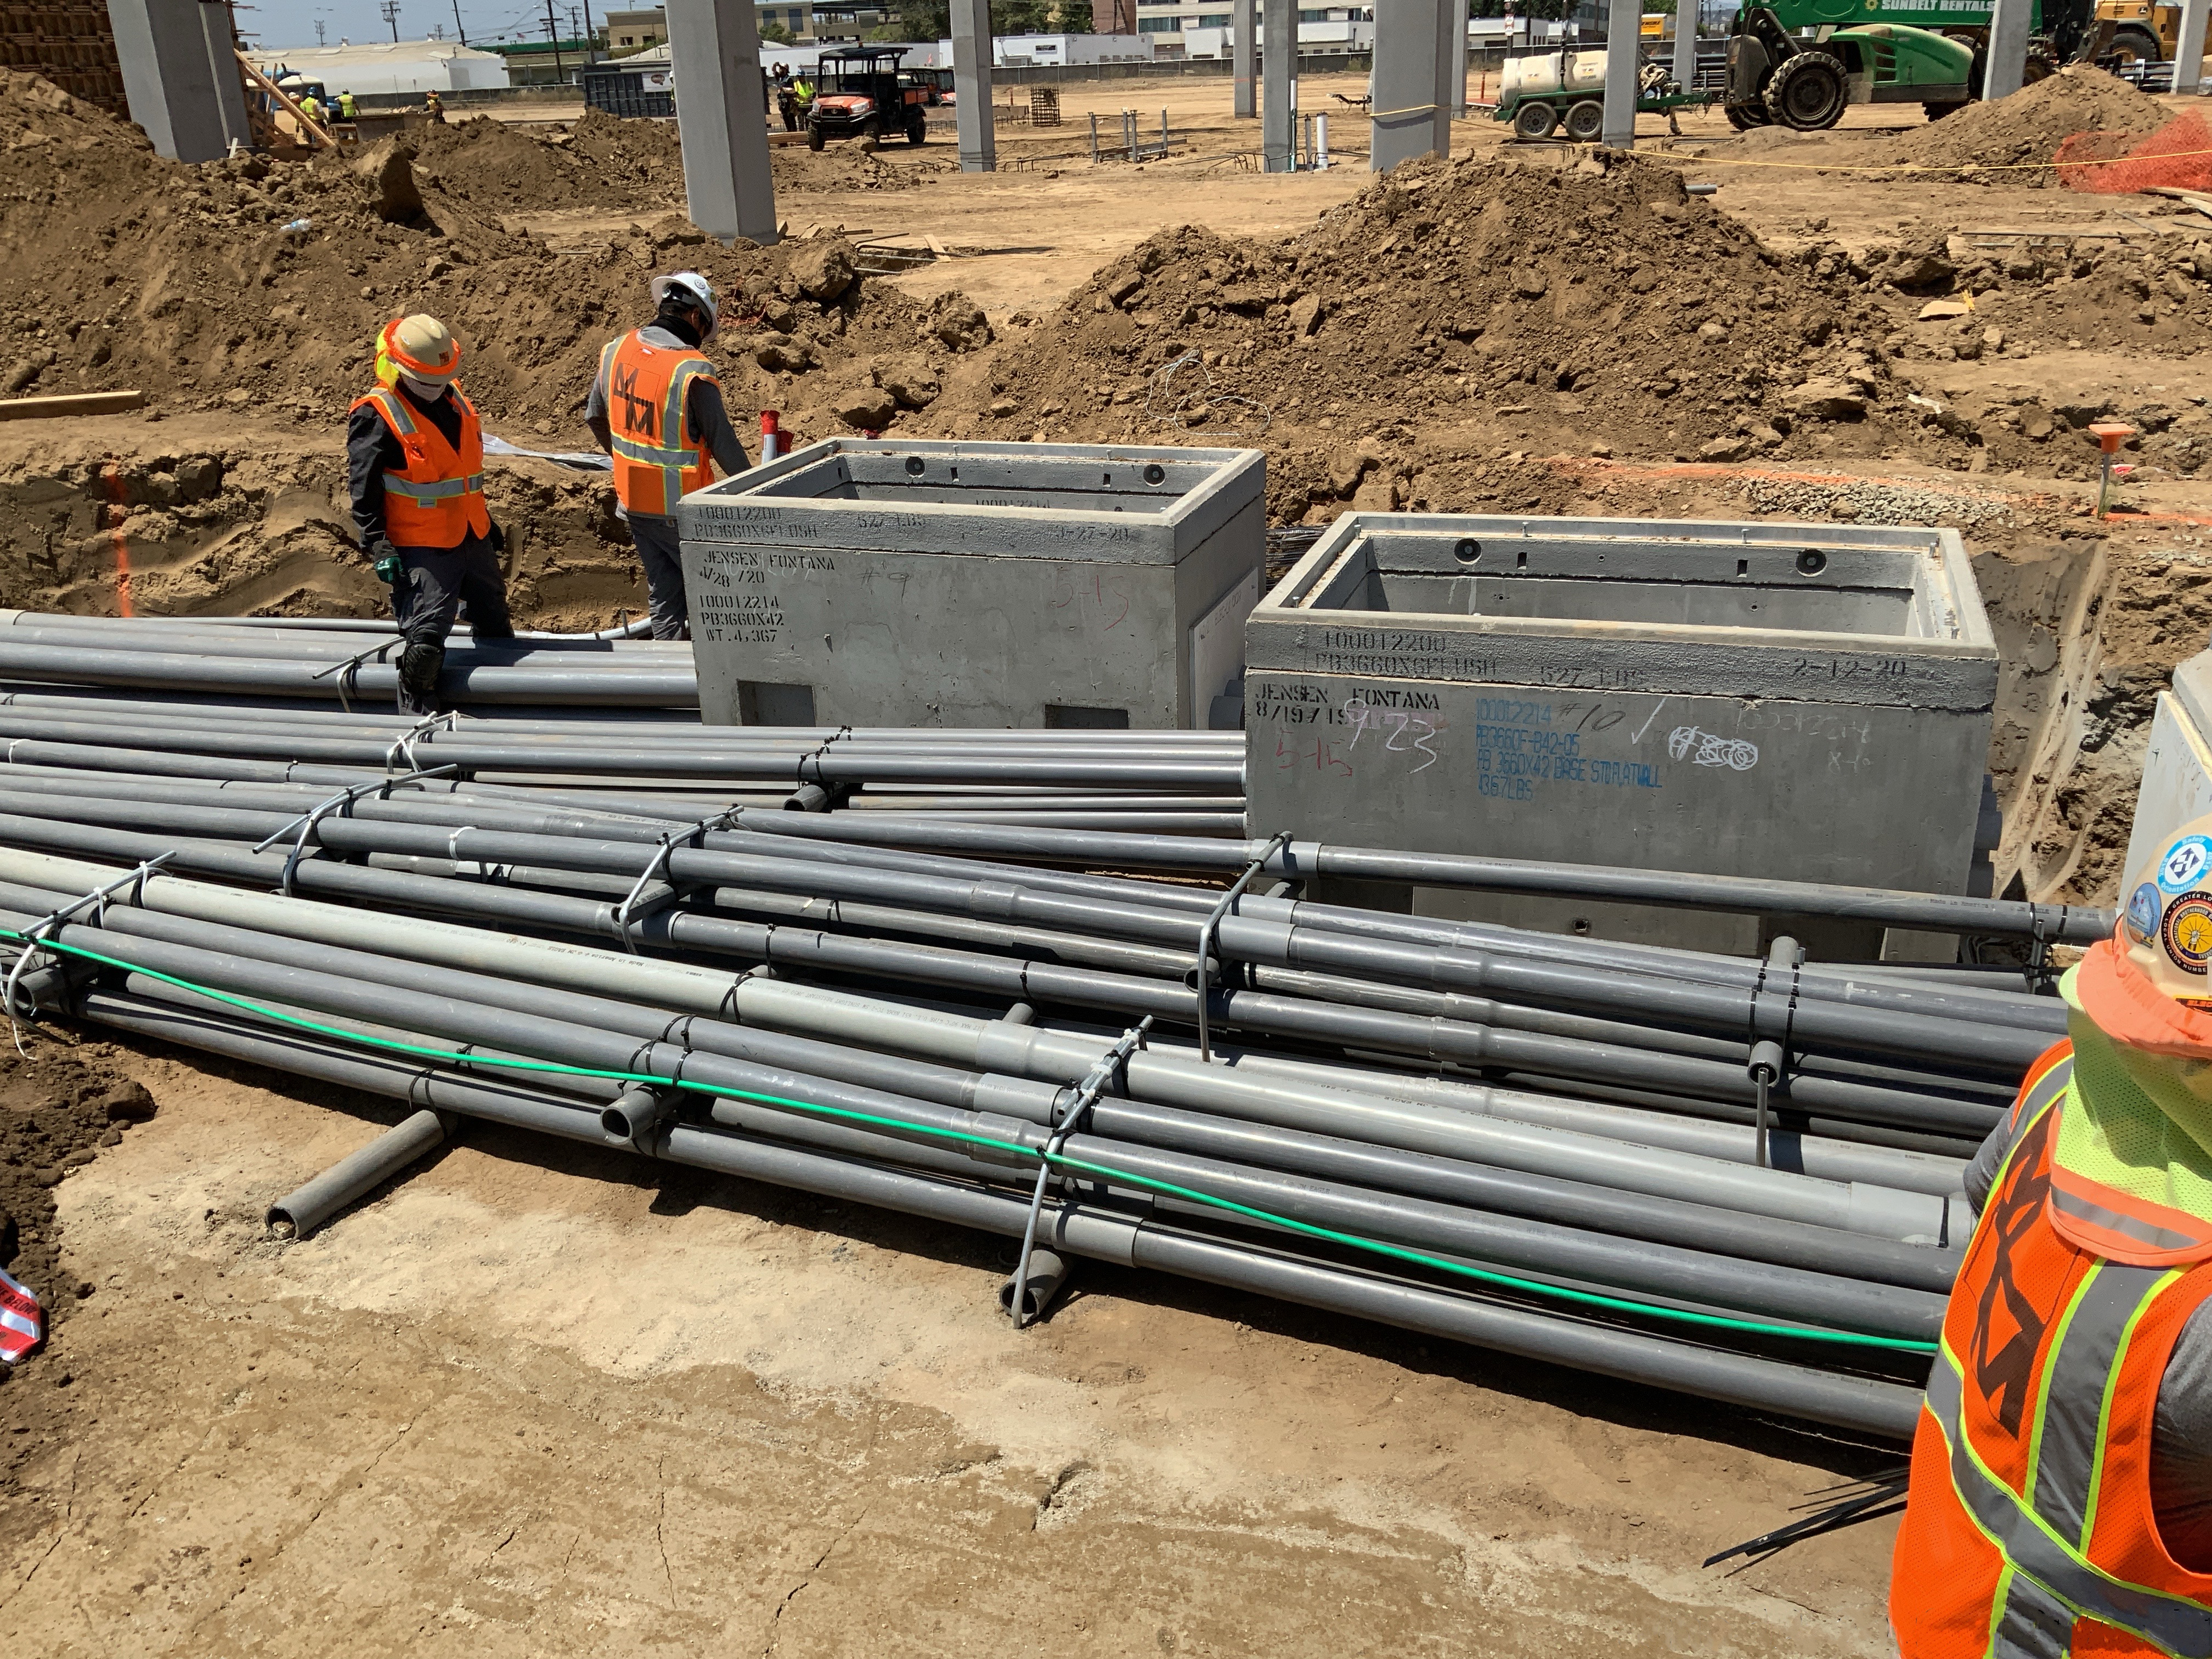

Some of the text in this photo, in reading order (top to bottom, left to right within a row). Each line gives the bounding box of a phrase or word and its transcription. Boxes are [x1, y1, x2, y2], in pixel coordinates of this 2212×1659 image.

[1881, 0, 1995, 12] SUNBELT RENTALS
[699, 506, 782, 521] 100012200
[704, 550, 759, 566] JENSEN
[770, 554, 835, 570] FONTANA
[699, 595, 780, 609] 100012214
[701, 612, 785, 626] PB3660X42
[1325, 632, 1446, 651] 100012200
[1255, 682, 1440, 710] JENSEN FONTANA
[2182, 837, 2205, 845] Safety
[2161, 877, 2200, 893] Orientation
[2172, 893, 2201, 909] GREATER
[548, 945, 566, 953] EAGLE
[2167, 945, 2181, 964] UNION
[591, 953, 616, 962] America
[805, 992, 834, 1004] RESISTANT
[1384, 1096, 1413, 1105] EAGLE
[1470, 1112, 1508, 1122] America
[1309, 1185, 1331, 1194] EAGLE
[4, 1295, 38, 1314] BELOW
